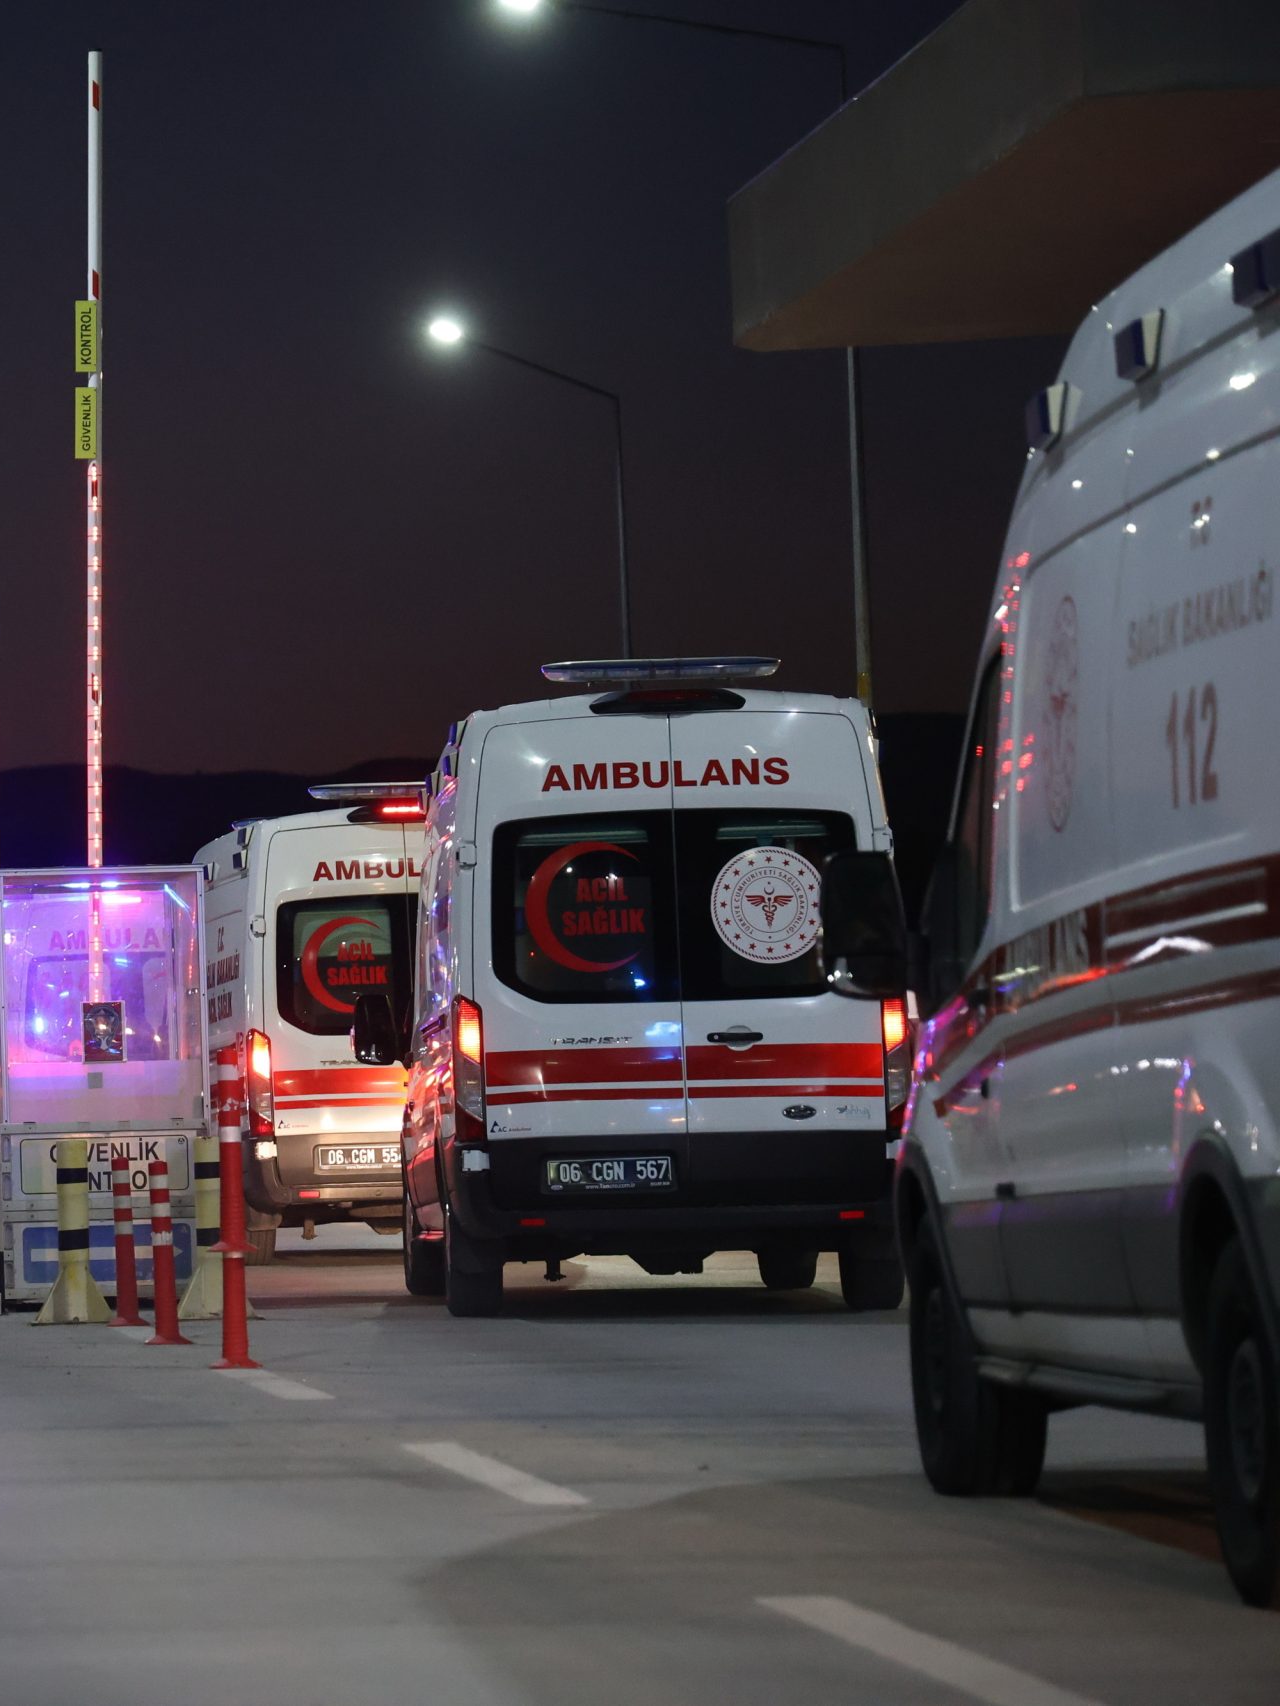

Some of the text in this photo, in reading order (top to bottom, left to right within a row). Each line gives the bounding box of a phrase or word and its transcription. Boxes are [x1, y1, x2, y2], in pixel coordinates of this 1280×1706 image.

[80, 307, 92, 365] KONTROL
[80, 394, 92, 451] GÜVENLİK
[1166, 681, 1219, 809] 112
[541, 756, 790, 792] AMBULANS
[313, 858, 422, 882] AMBUL
[562, 905, 645, 937] SAĞLIK
[49, 927, 160, 950] AMULA
[337, 939, 376, 961] ACİL
[327, 962, 388, 986] SAĞLIK
[49, 1137, 159, 1163] VENLİK
[328, 1149, 345, 1165] 06
[382, 1147, 401, 1162] 55
[559, 1160, 668, 1182] 06 CGN 567
